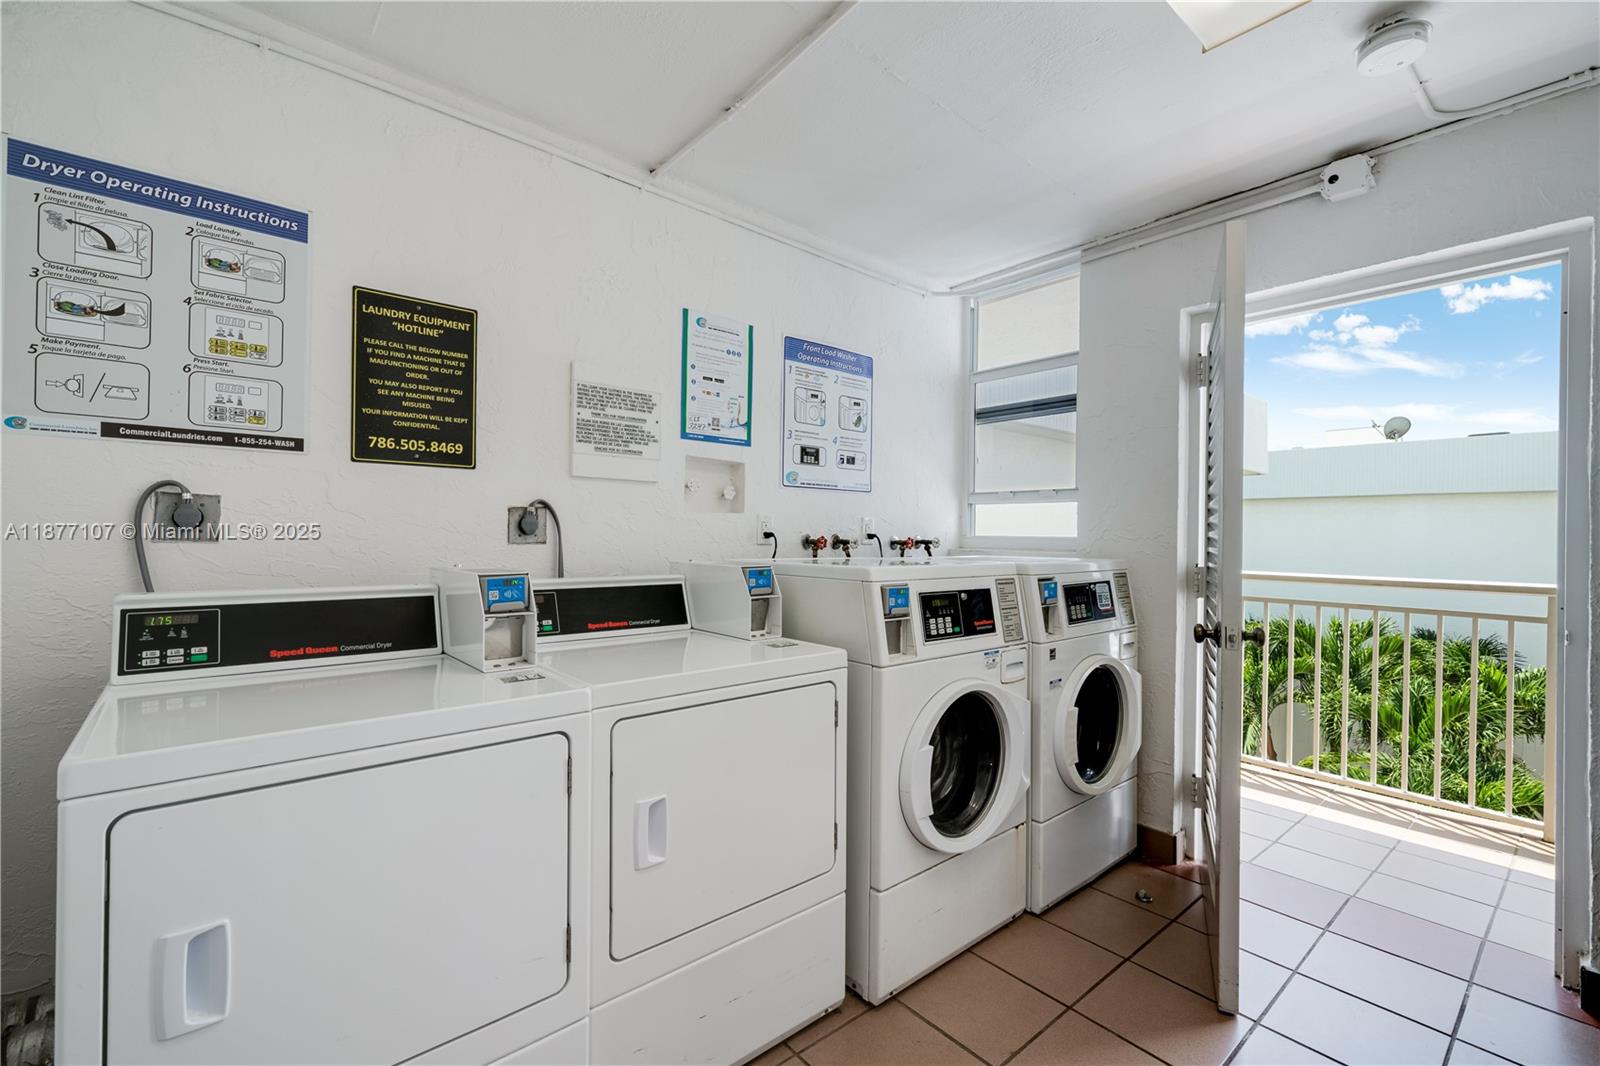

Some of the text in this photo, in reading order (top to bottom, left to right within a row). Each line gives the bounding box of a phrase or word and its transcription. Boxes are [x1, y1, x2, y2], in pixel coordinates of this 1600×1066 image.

[22, 153, 299, 231] Dryer Operating Instructions
[33, 192, 40, 203] 1
[44, 187, 107, 206] Clean Lint Filter.
[44, 194, 69, 207] Limpie
[77, 201, 94, 210] filtro
[95, 204, 104, 212] de
[185, 226, 194, 236] 2
[196, 221, 213, 230] Load
[196, 228, 221, 239] Coloque
[29, 267, 39, 277] 3
[42, 262, 120, 281] Close Loading Door.
[42, 269, 64, 277] Cierre
[183, 296, 192, 306] 4
[205, 292, 226, 300] Fabric
[227, 295, 253, 305] Selector.
[362, 304, 471, 331] LAUNDRY EQUIPMENT
[27, 343, 39, 354] 5
[41, 337, 101, 350] Make Payment.
[363, 337, 387, 347] PLEASE
[388, 340, 404, 349] CALL
[418, 346, 441, 355] BELOW
[442, 349, 468, 359] NUMBER
[73, 349, 96, 357] tarjeta
[802, 343, 821, 353] Front
[821, 347, 836, 357] Load
[369, 357, 429, 371] MALFUNCTIONING
[390, 350, 406, 359] FIND
[413, 354, 442, 364] MACHINE
[443, 359, 459, 367] THAT
[797, 352, 829, 366] Operating
[183, 364, 192, 373] 6
[193, 364, 218, 372] Presione
[788, 365, 792, 374] 1
[405, 371, 430, 380] ORDER.
[833, 375, 839, 384] 2
[369, 378, 383, 386] YOU
[418, 383, 442, 393] REPORT
[450, 388, 463, 396] YOU
[377, 388, 455, 403] SEE ANY MACHINE BEING
[402, 401, 432, 409] MISUSED.
[361, 407, 381, 415] YOUR
[382, 409, 428, 420] INFORMATION
[429, 413, 443, 422] WILL
[393, 420, 440, 430] CONFIDENTIAL.
[119, 427, 295, 447] CommercialLaundries.com 1-855-254-WASH
[787, 430, 792, 439] 3
[832, 436, 837, 445] 4
[368, 436, 463, 454] 786.505.8469
[270, 648, 304, 658] Speed
[340, 643, 375, 652] Commercial
[376, 642, 392, 650] Dryer
